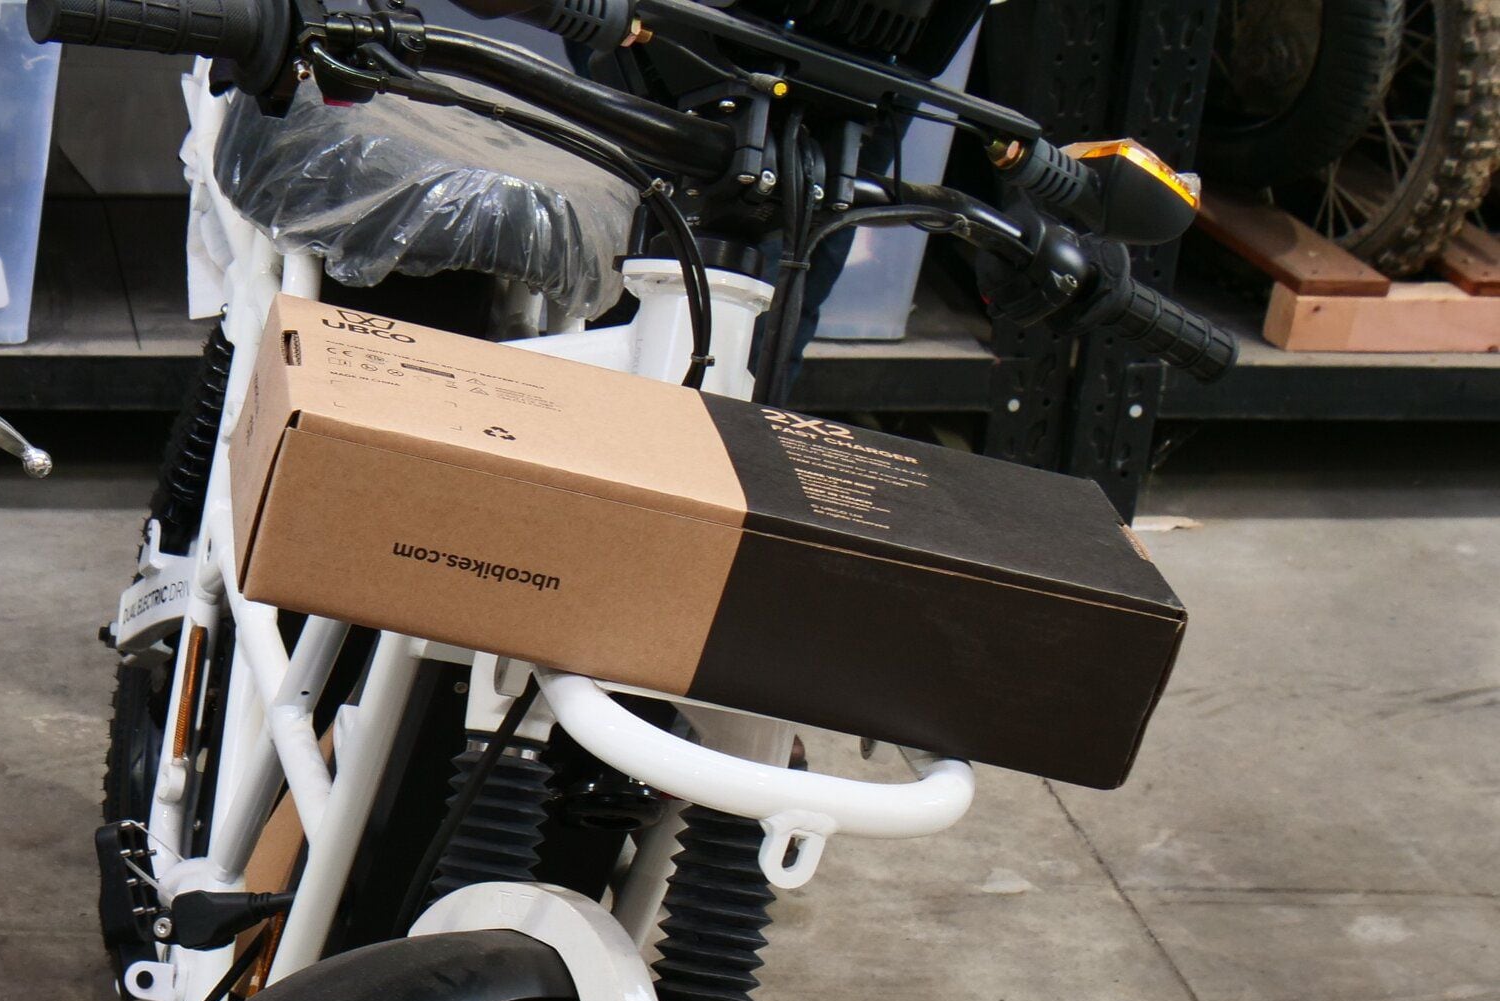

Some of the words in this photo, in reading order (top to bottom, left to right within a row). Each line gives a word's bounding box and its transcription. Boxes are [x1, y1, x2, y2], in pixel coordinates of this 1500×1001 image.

[322, 318, 416, 343] UBCO
[761, 408, 855, 440] 2X2
[770, 424, 818, 440] FAST
[823, 437, 920, 465] CHARGER
[392, 542, 561, 591] ubcobikes.com
